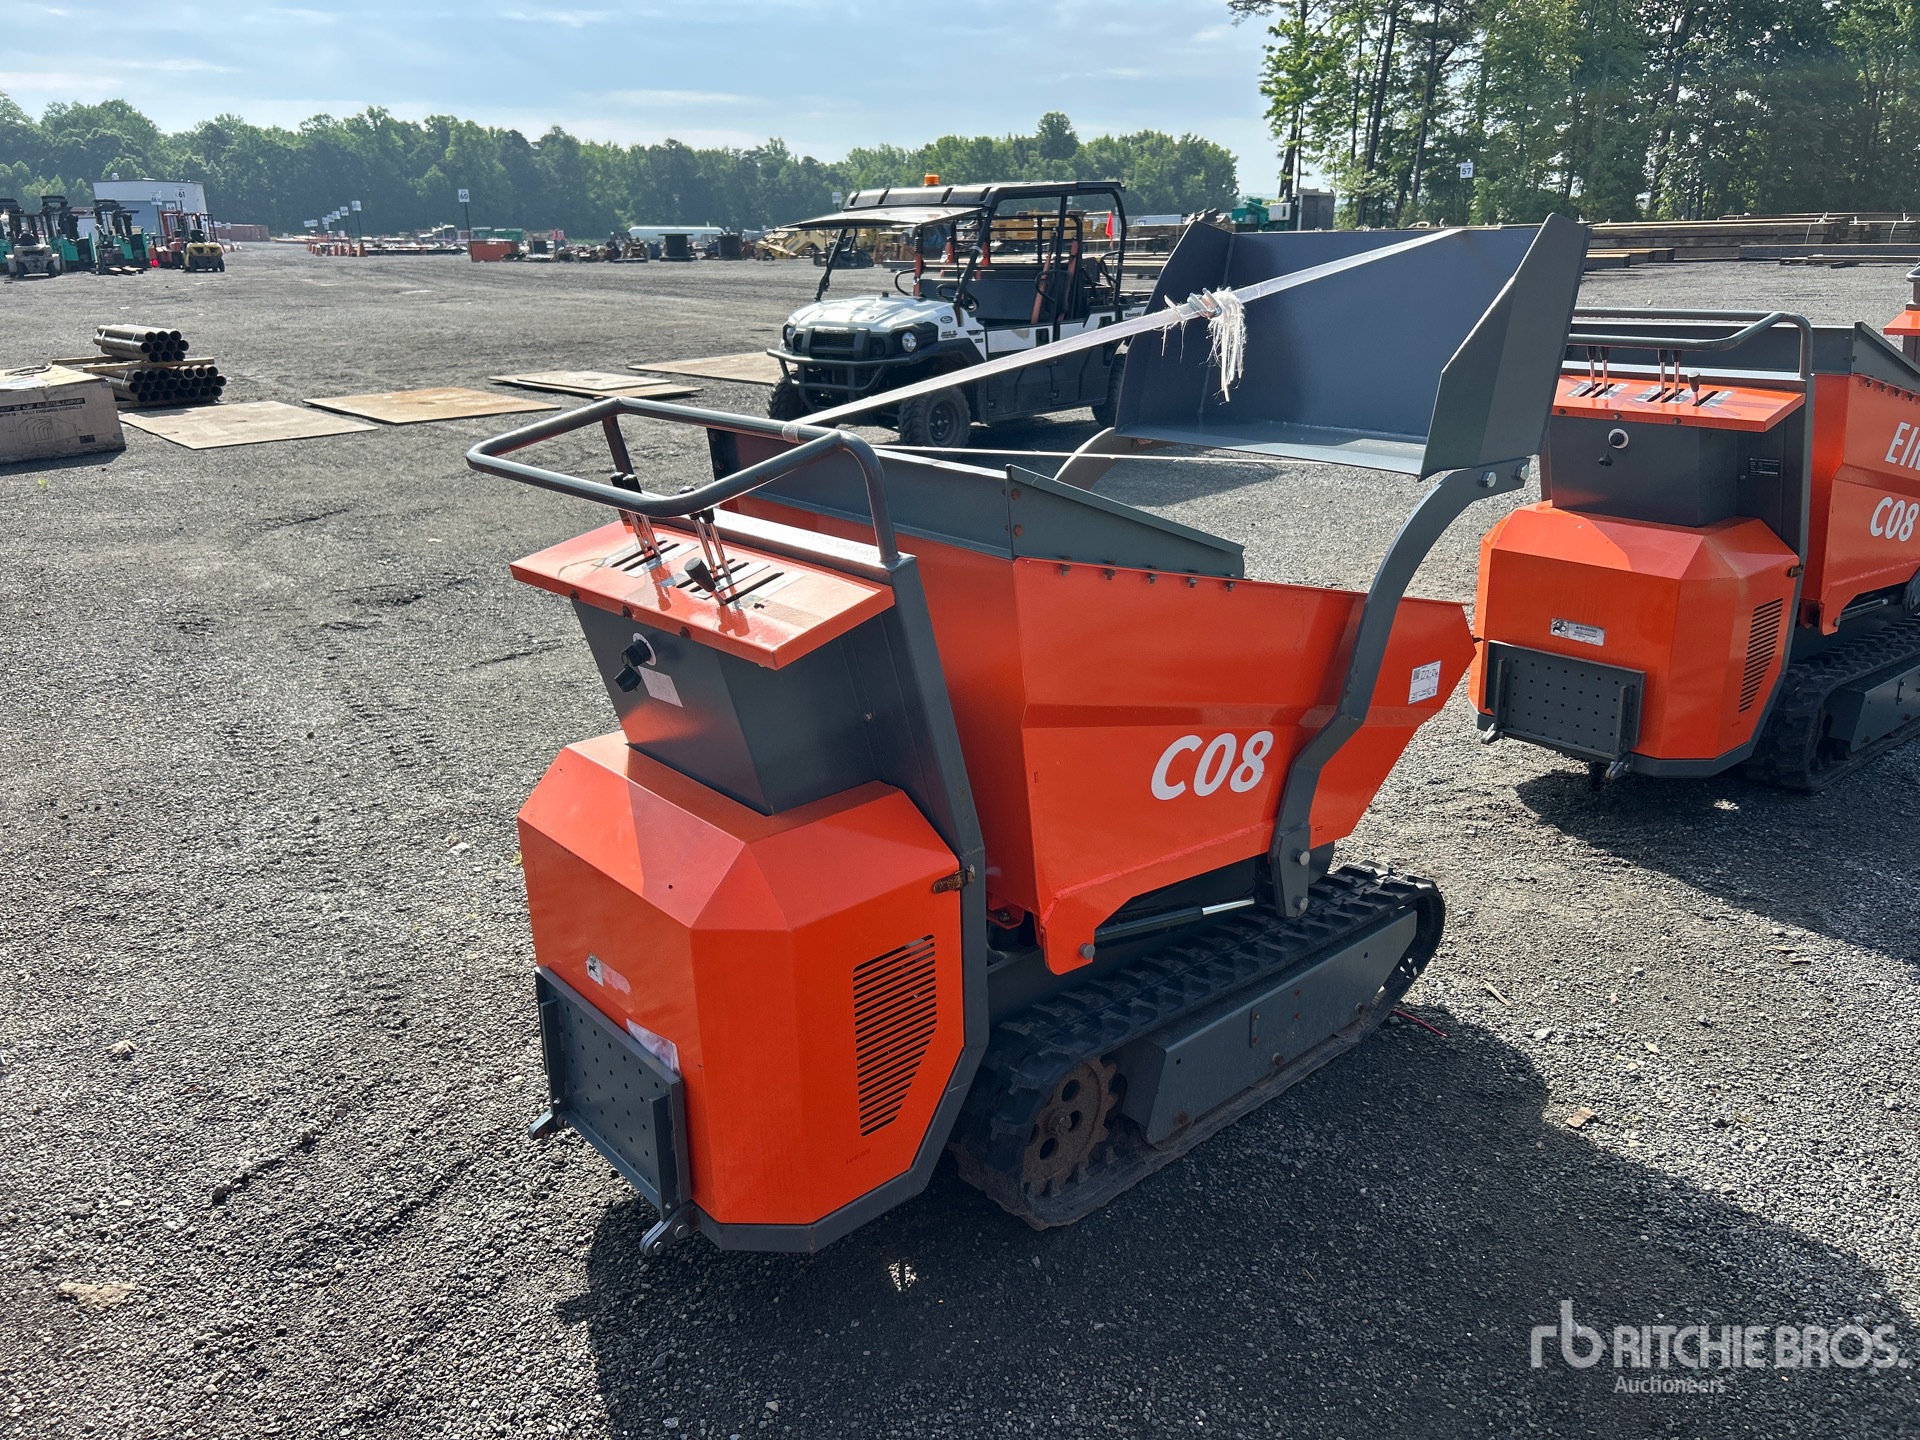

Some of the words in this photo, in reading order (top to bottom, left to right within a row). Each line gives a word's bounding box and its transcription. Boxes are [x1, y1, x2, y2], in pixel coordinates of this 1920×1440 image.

[1462, 167, 1472, 175] 57
[1870, 496, 1919, 542] C08
[1151, 730, 1274, 800] C08
